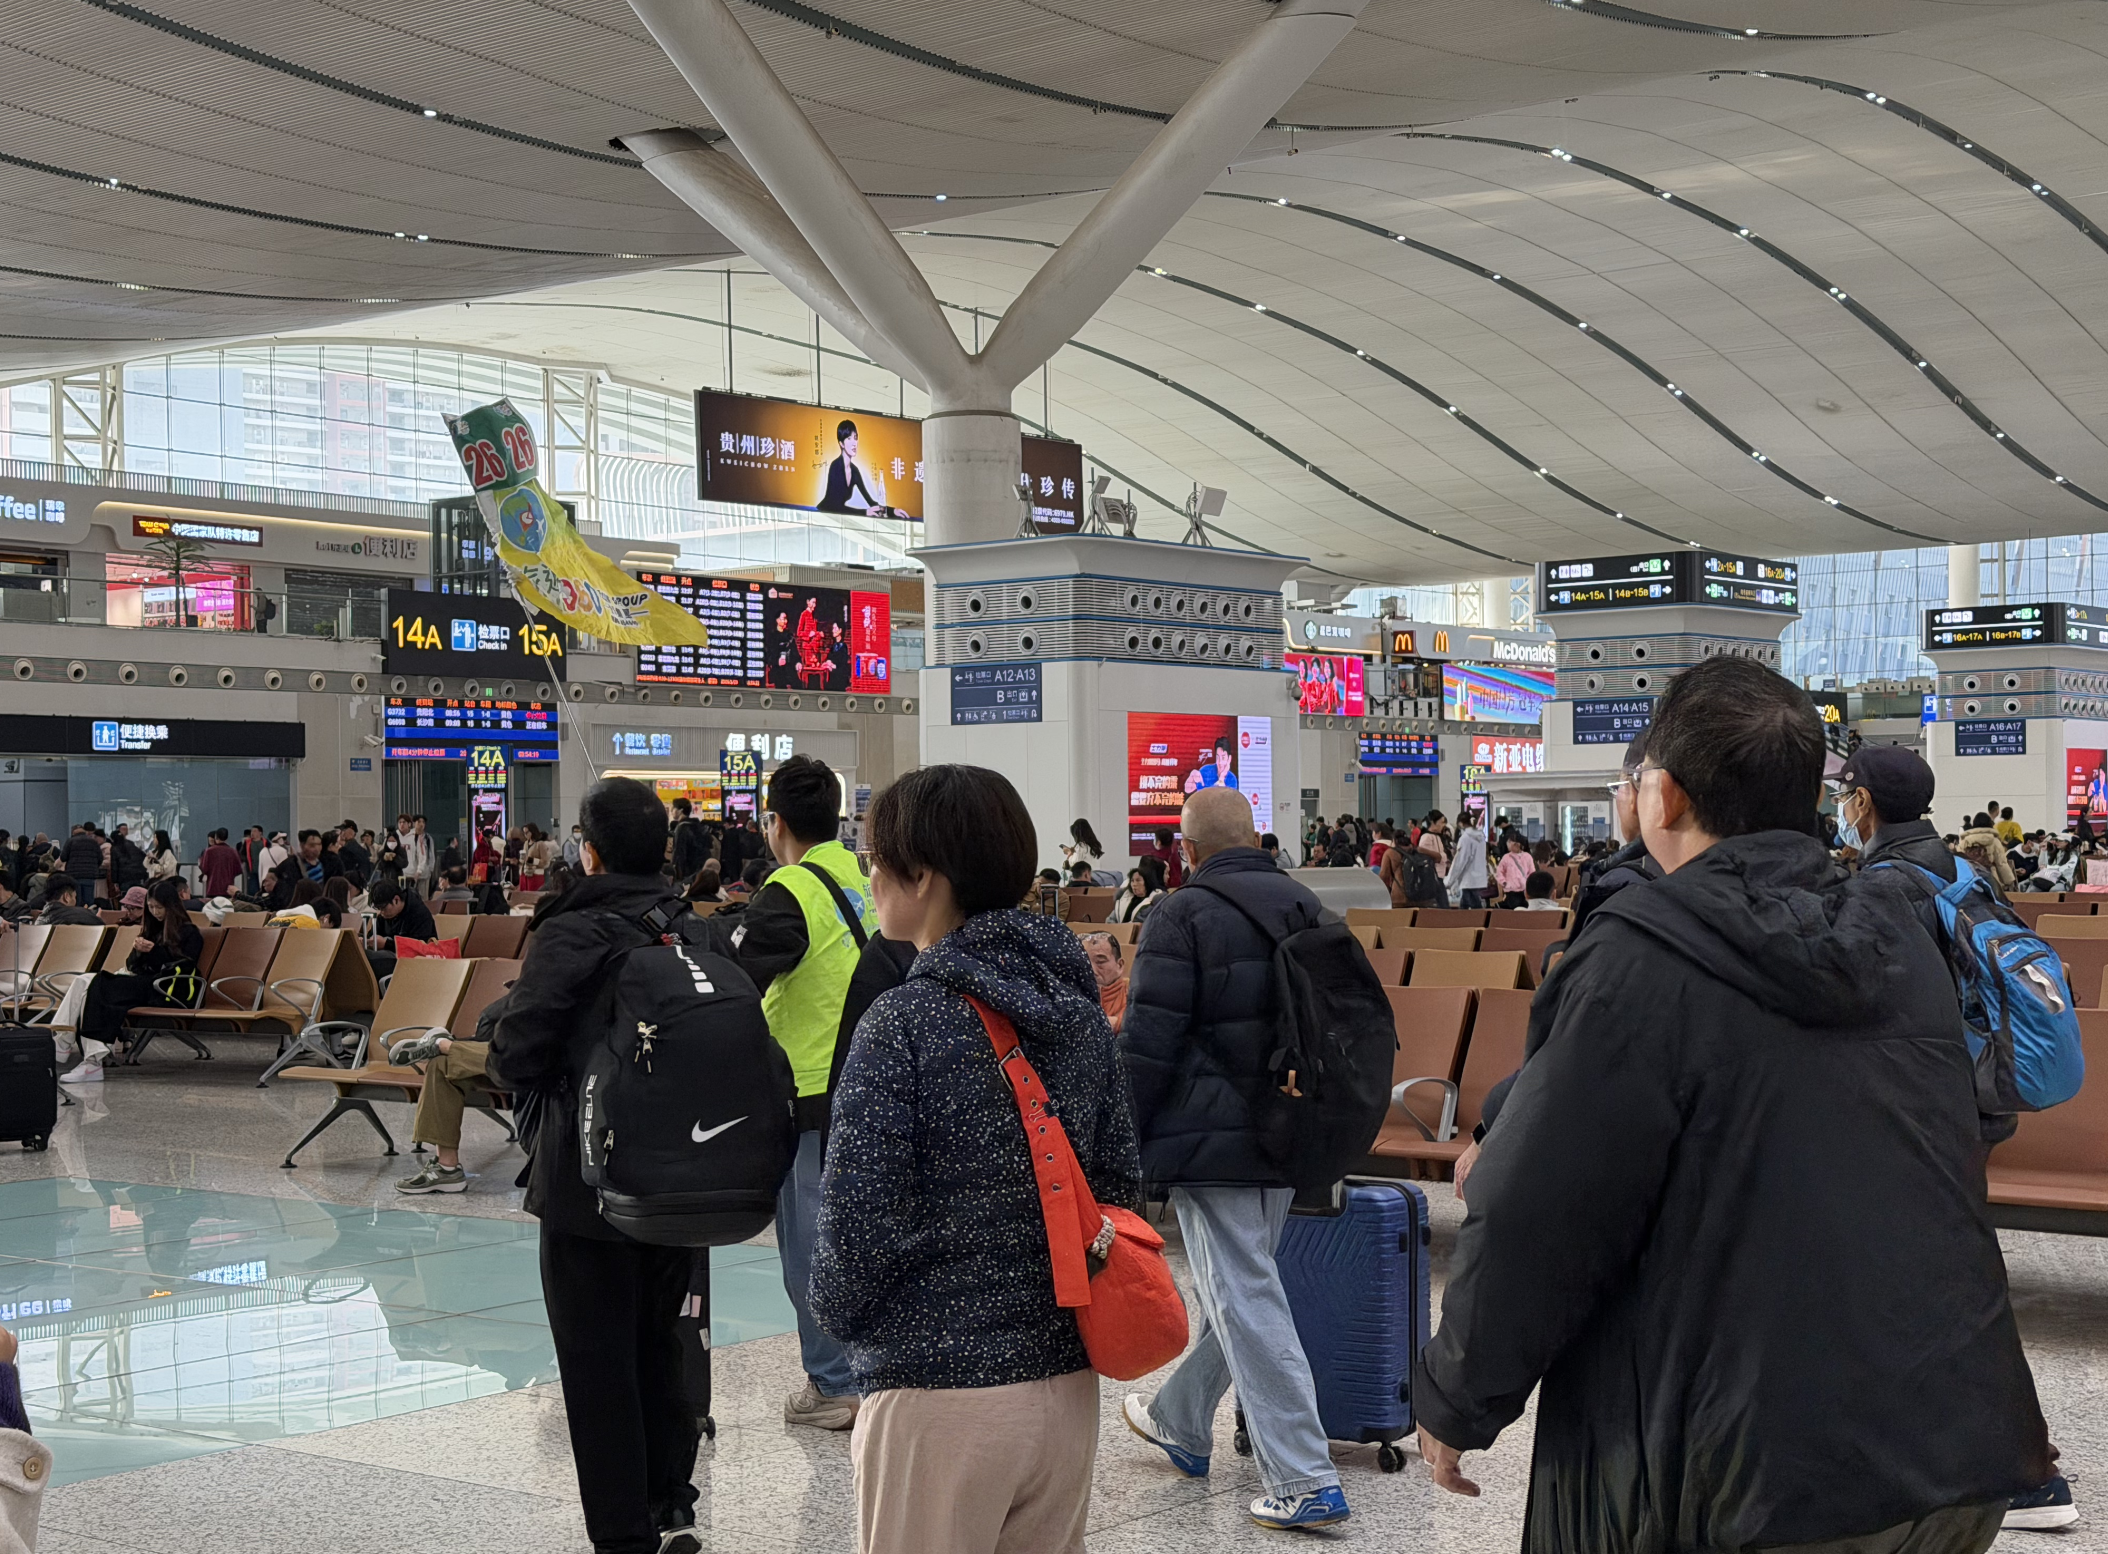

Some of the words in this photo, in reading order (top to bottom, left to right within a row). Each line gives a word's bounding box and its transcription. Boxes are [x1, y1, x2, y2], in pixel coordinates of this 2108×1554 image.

[462, 439, 507, 490] 26
[502, 423, 535, 473] 26
[363, 535, 418, 559] 便利店
[1571, 590, 1605, 602] 14A-15A
[1615, 588, 1649, 599] 14B-15B
[392, 615, 443, 650] 14A
[478, 624, 510, 641] 检票口
[518, 624, 563, 657] 15A
[478, 640, 500, 650] Check
[1493, 641, 1556, 663] McDonald's
[997, 690, 1005, 703] B
[120, 724, 169, 739] 便捷换乘
[1614, 718, 1621, 728] B
[120, 740, 151, 750] Transfer
[726, 733, 793, 760] 便利店
[471, 750, 505, 767] 14A
[724, 755, 756, 771] 15A
